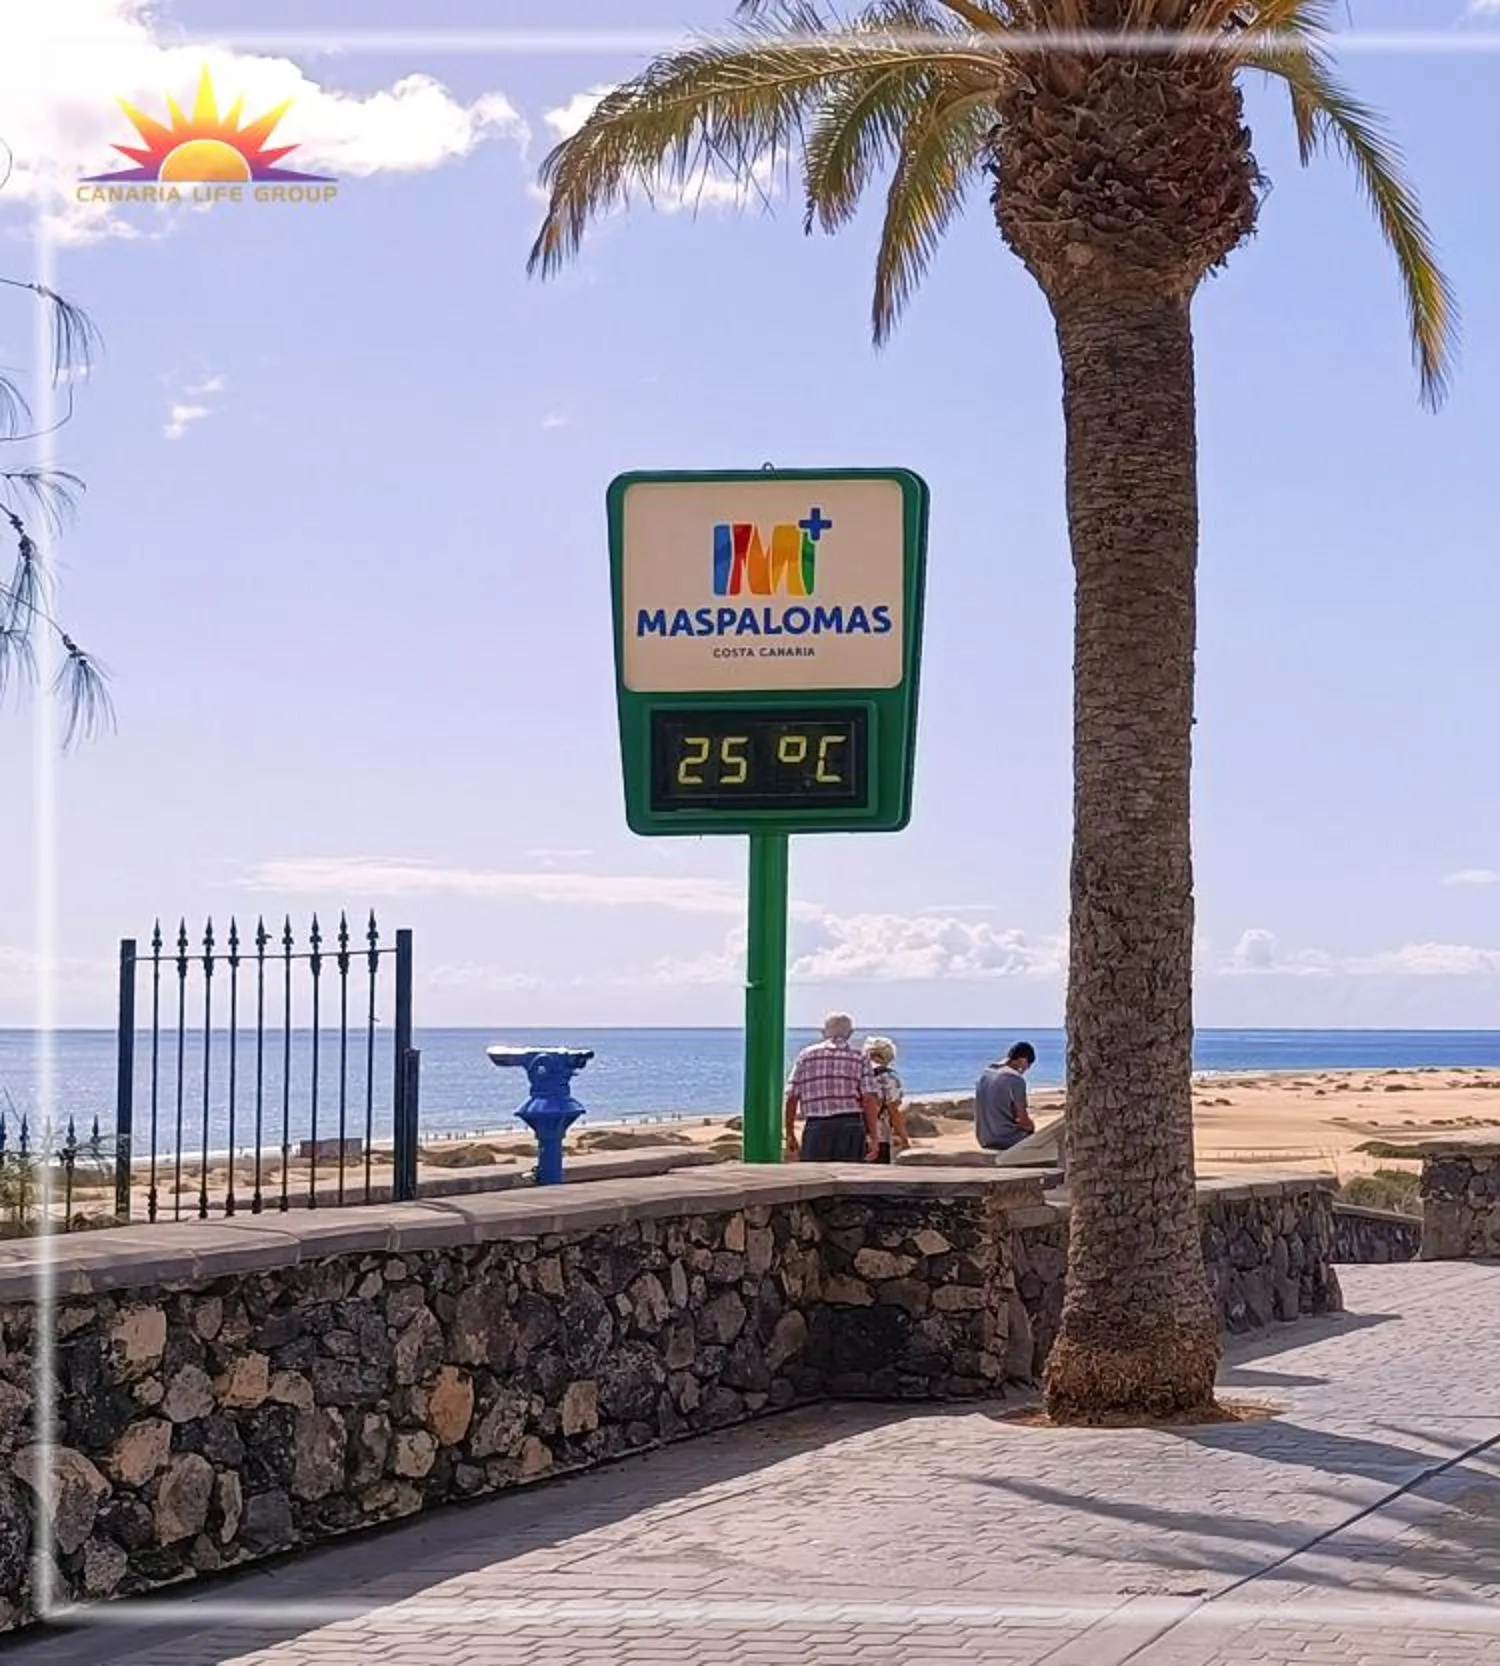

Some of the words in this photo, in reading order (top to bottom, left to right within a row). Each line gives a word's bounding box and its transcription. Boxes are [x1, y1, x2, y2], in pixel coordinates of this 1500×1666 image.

[636, 605, 892, 637] MASPALOMAS
[713, 647, 755, 659] COSTA
[759, 646, 815, 658] CANARIA
[677, 736, 749, 784] 25
